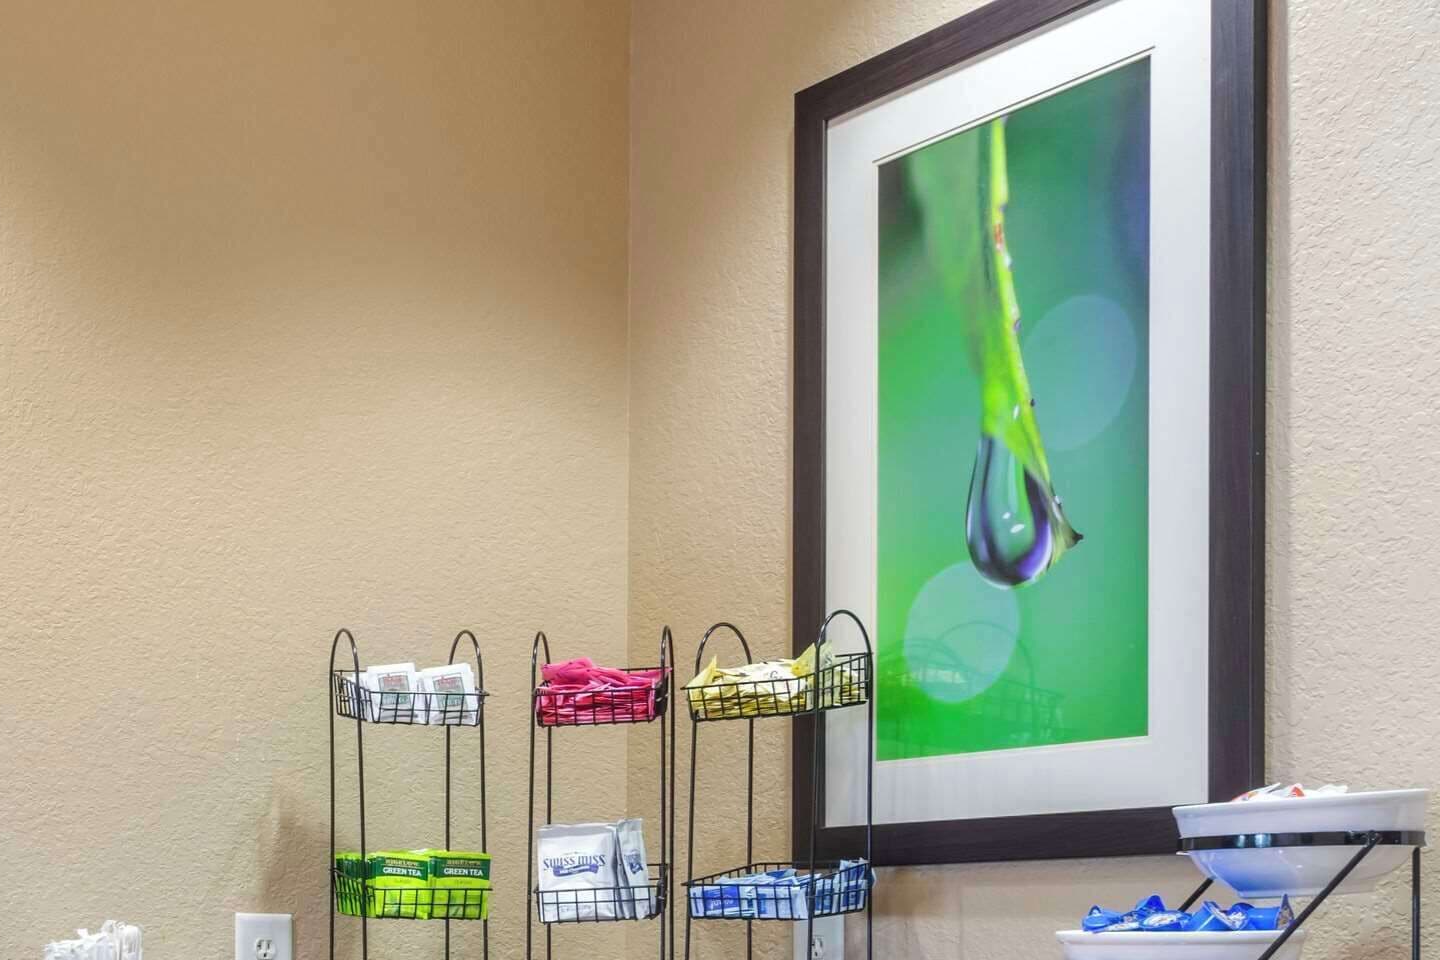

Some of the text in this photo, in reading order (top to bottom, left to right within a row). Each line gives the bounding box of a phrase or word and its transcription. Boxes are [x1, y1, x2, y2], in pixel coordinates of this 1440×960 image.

[382, 867, 423, 877] GREEN TEA
[443, 867, 484, 877] GREEN TEA
